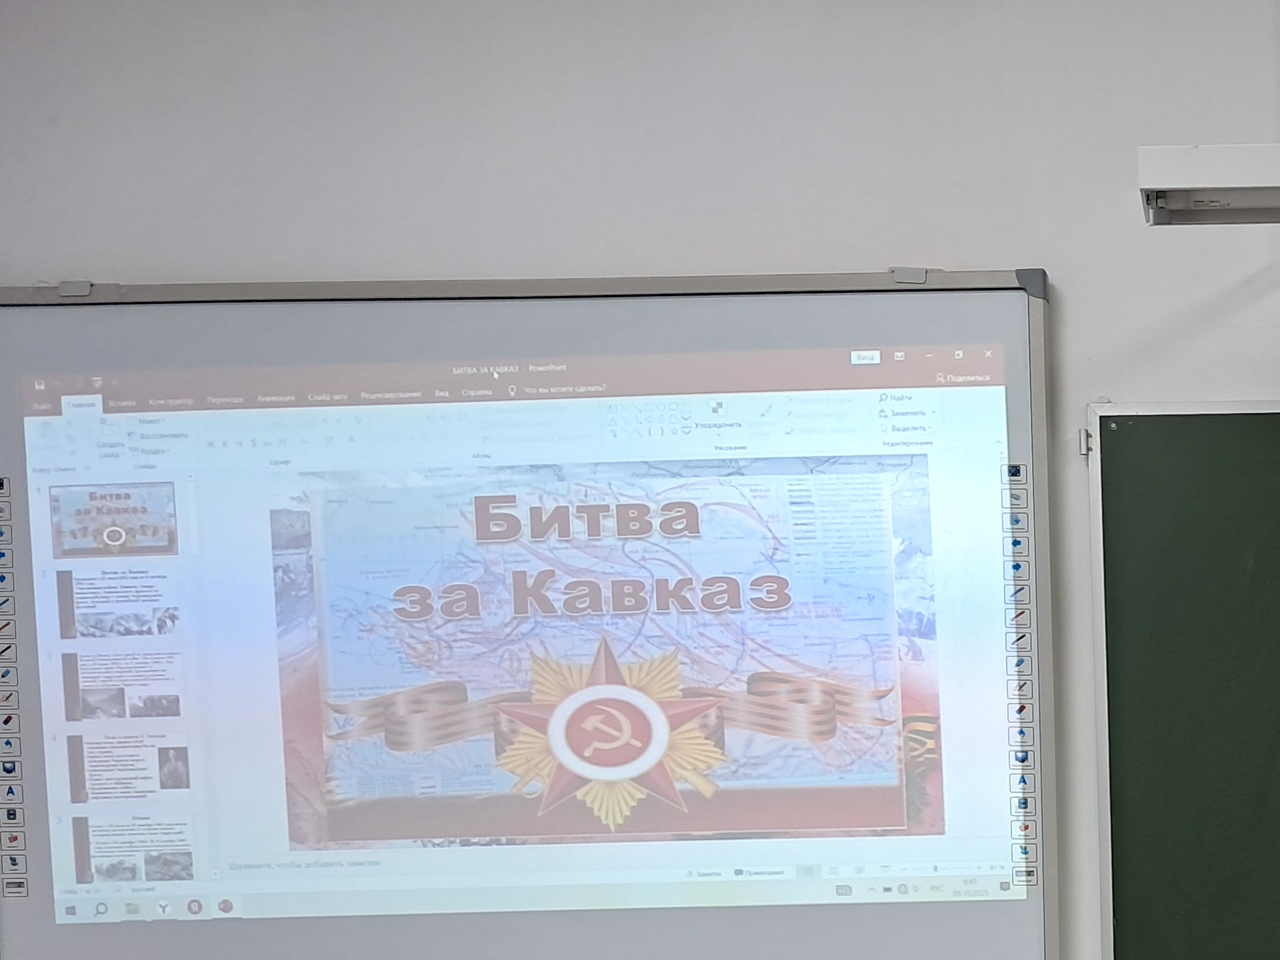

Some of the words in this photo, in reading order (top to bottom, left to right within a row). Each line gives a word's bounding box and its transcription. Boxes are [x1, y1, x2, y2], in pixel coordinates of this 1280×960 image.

[452, 366, 478, 375] БИТВА
[528, 363, 567, 372] PowerPoint
[946, 373, 991, 383] Поделиться
[89, 491, 131, 501] Битва
[95, 505, 148, 516] Кавказ
[473, 494, 702, 543] Битва
[392, 583, 483, 621] за
[511, 568, 793, 617] Кавказ
